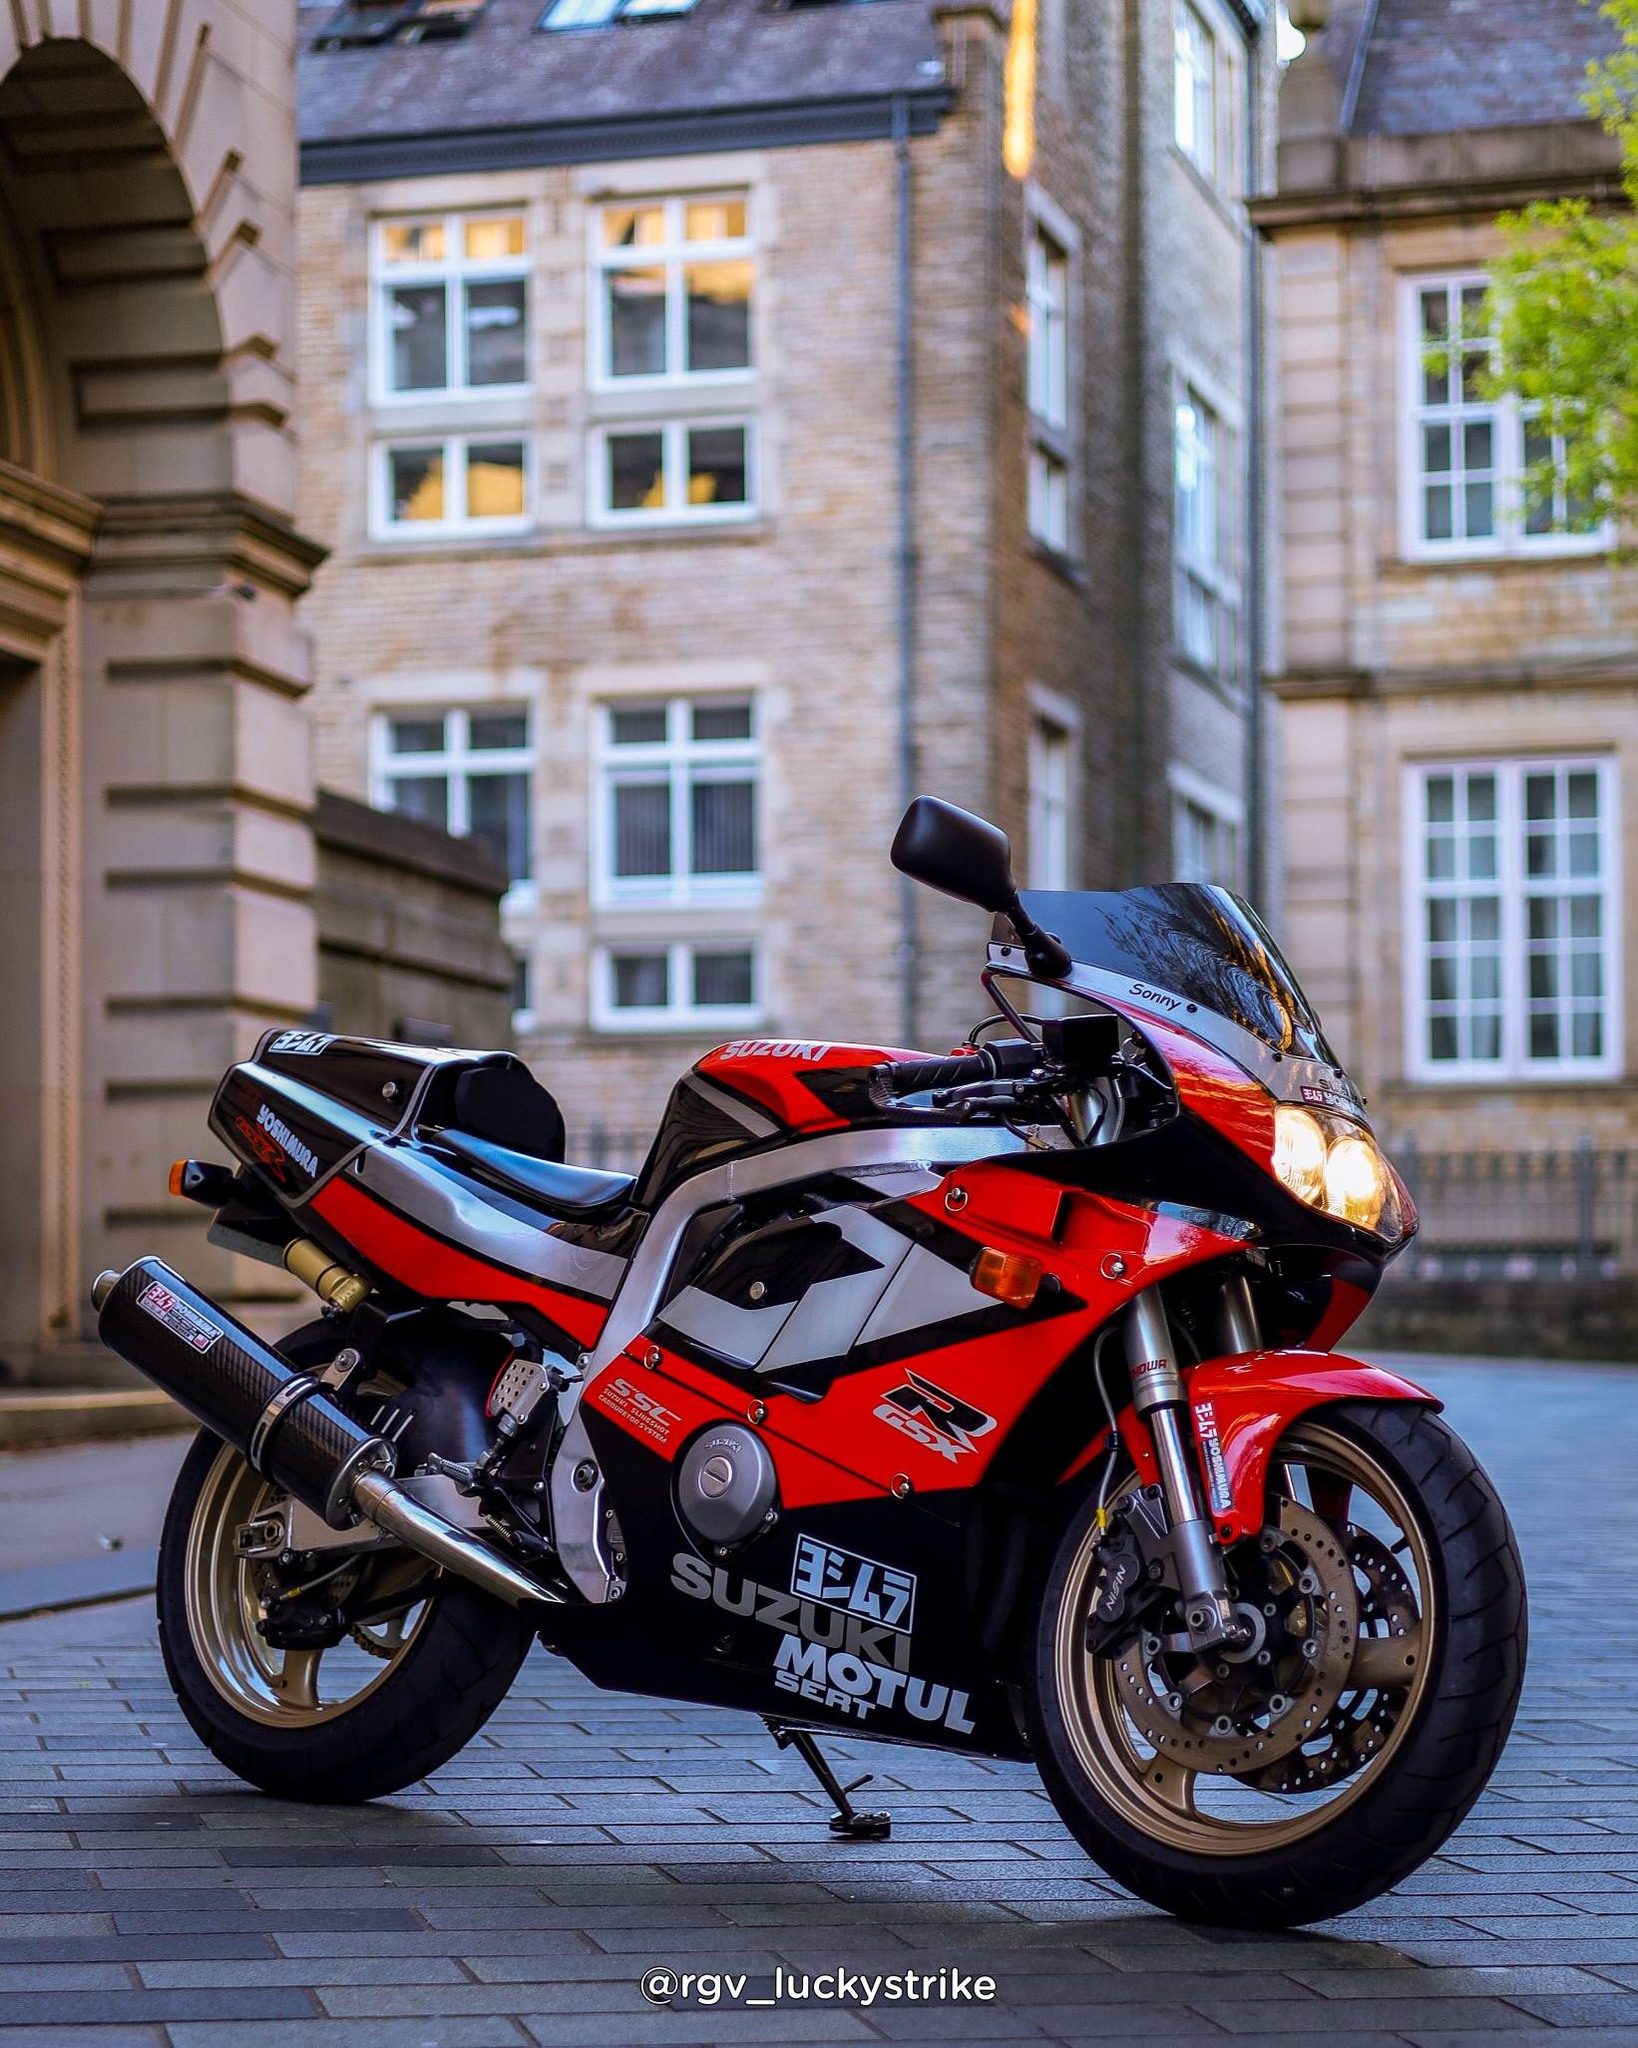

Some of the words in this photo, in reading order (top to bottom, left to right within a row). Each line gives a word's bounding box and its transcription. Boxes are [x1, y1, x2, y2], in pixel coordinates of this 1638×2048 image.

[1128, 983, 1182, 1012] Sonny
[719, 1041, 831, 1062] SUZUKI
[256, 1103, 319, 1178] YOSHIMURA
[1131, 1358, 1167, 1378] HOWA
[598, 1394, 640, 1425] CARBURETOR
[638, 1422, 668, 1444] SYSTEM
[603, 1388, 628, 1407] SUZUKI
[630, 1407, 670, 1436] SLINGSHOT
[872, 1403, 972, 1464] GSX
[1208, 1437, 1232, 1509] YOSHIMURA
[669, 1552, 912, 1673] SUZUKI
[1105, 1564, 1127, 1612] NISSIN
[772, 1633, 976, 1735] MOTUL
[774, 1669, 876, 1720] SERT
